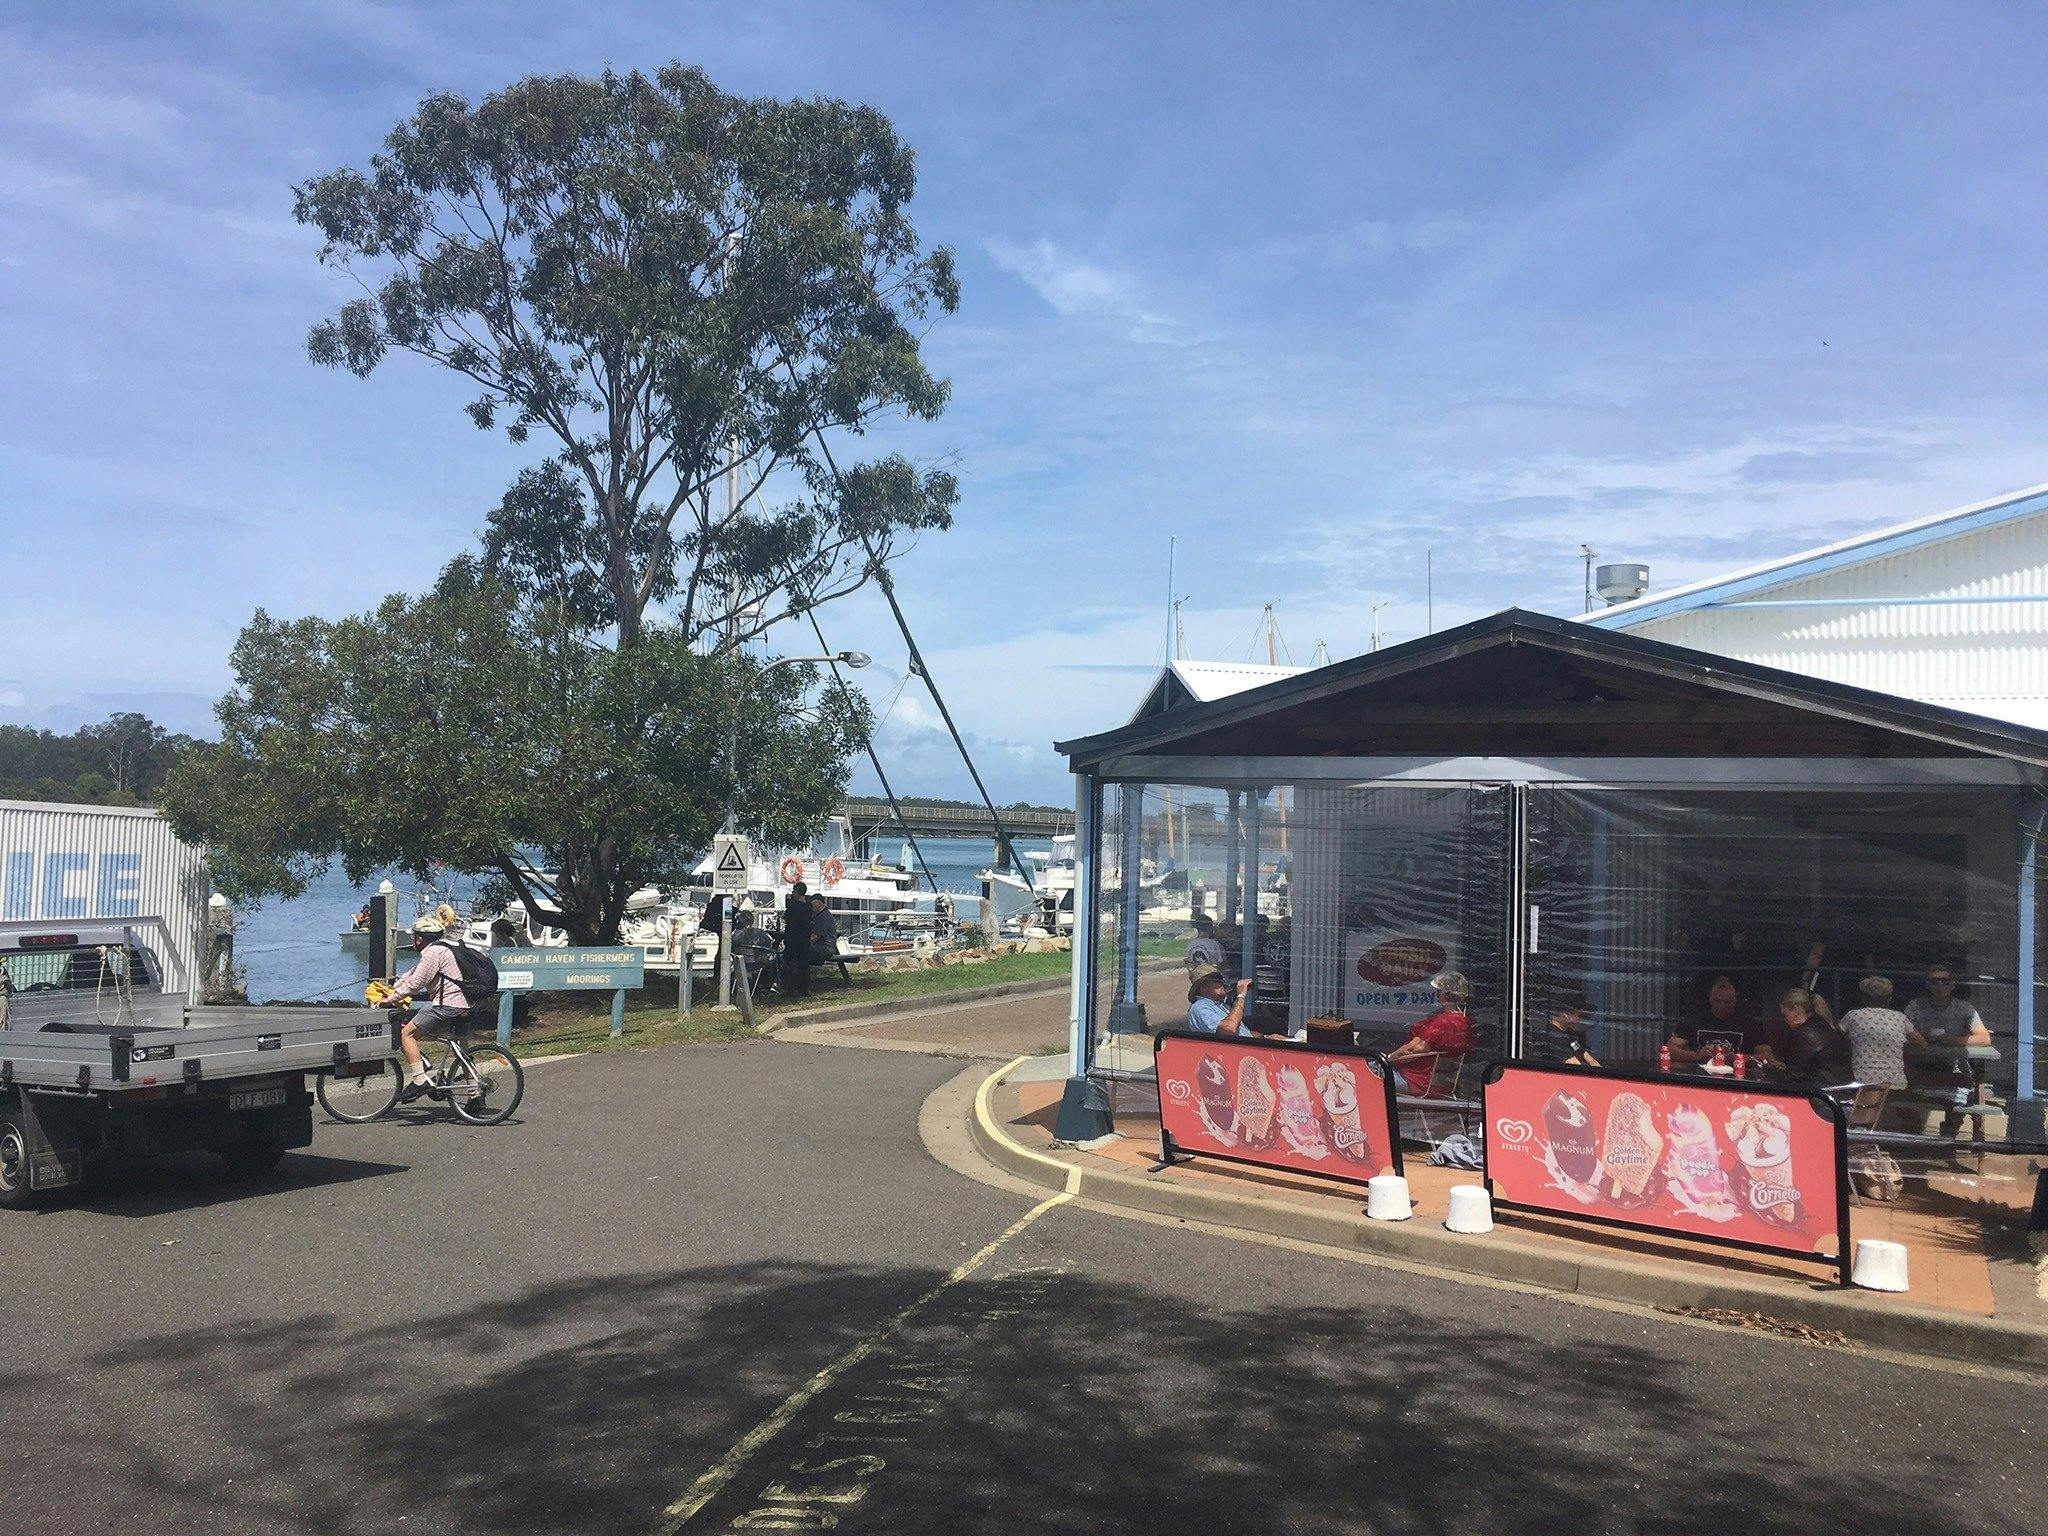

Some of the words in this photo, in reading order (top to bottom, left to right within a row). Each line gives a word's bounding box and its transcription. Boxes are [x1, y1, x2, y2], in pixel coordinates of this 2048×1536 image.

[4, 852, 142, 917] ICE
[500, 954, 540, 964] CAMDEN
[545, 953, 575, 963] HAVEN
[581, 952, 636, 963] FISHERMENS
[566, 974, 611, 984] MOORINGS
[1356, 992, 1390, 1006] OPEN
[1393, 992, 1408, 1006] 7
[1170, 1098, 1191, 1107] STREETS
[1203, 1096, 1233, 1108] MAGNUM
[1243, 1098, 1263, 1107] Golden
[1240, 1105, 1268, 1116] Gaytime
[1333, 1125, 1368, 1149] Cornetto
[1501, 1142, 1530, 1153] STREETS
[1551, 1141, 1595, 1156] MAGNUM
[1613, 1146, 1641, 1155] Golden
[1606, 1153, 1649, 1166] Gaytime
[1750, 1179, 1802, 1210] Cornetto
